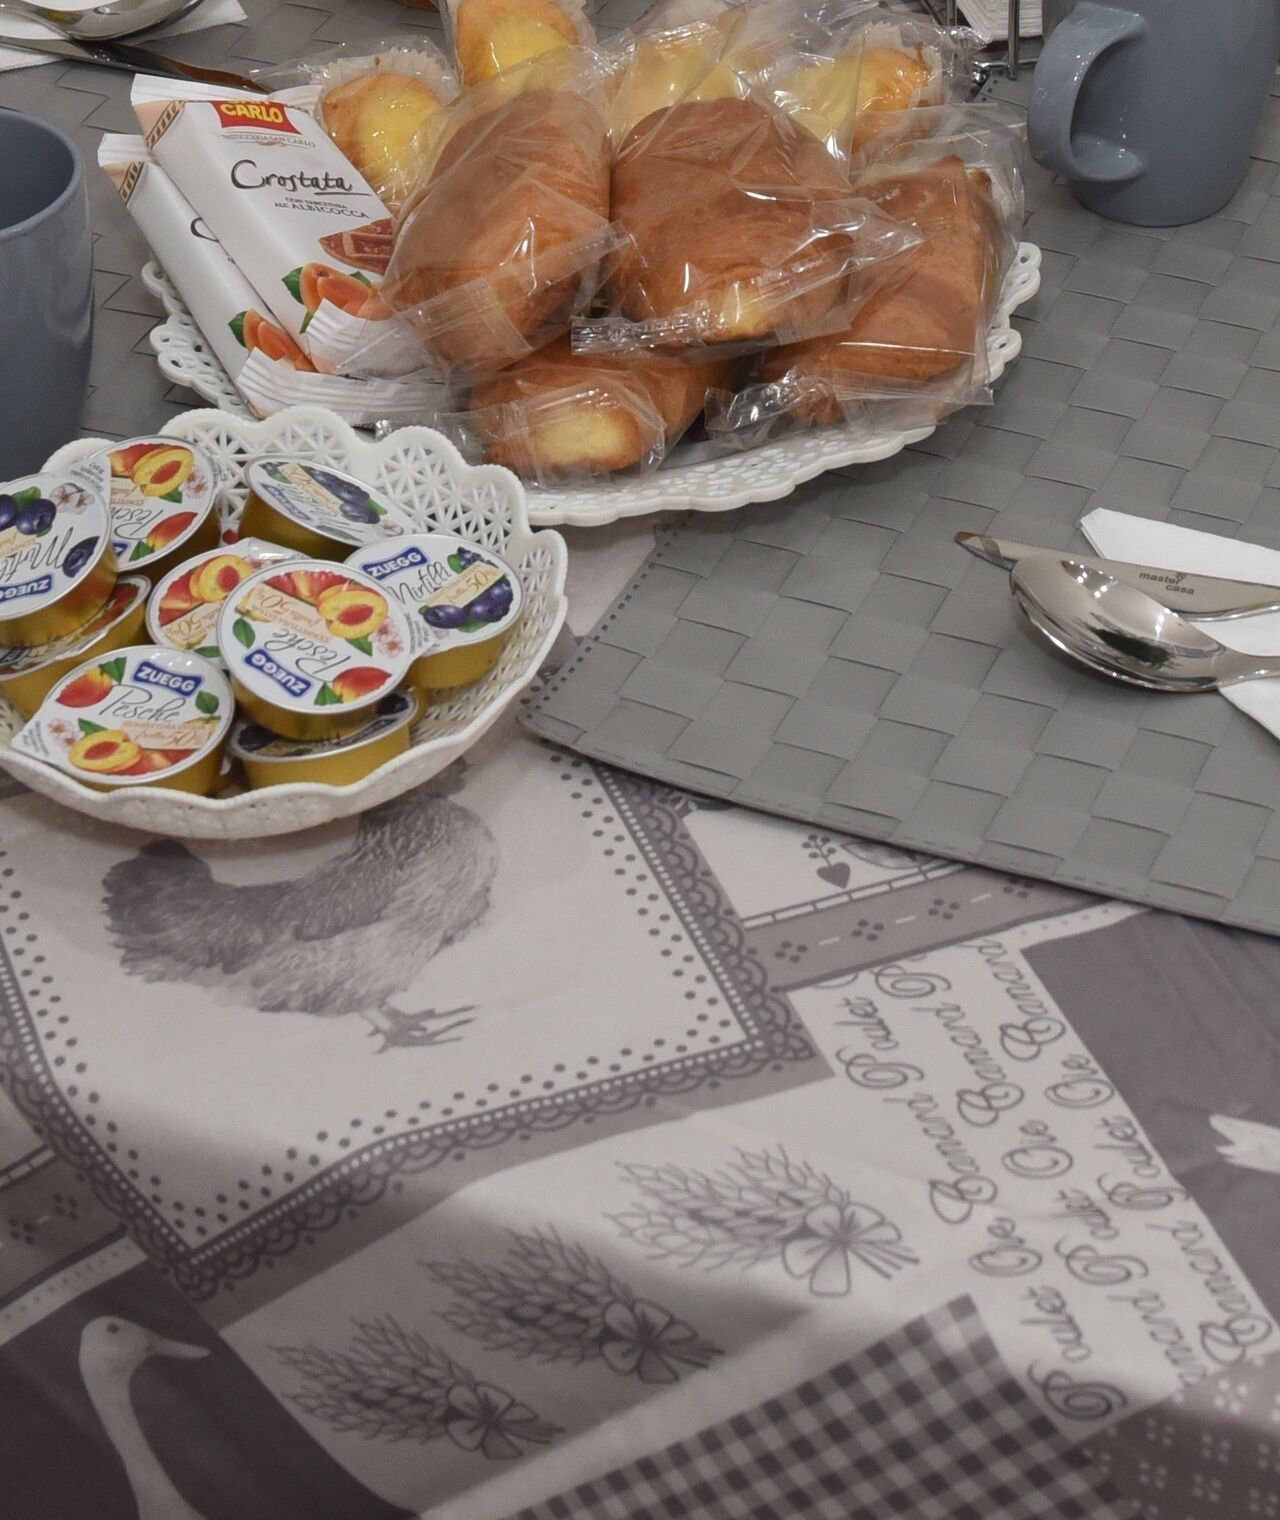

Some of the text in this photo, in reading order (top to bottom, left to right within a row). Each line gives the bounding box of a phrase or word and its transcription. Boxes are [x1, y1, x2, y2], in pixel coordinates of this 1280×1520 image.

[220, 103, 284, 124] CARLO
[230, 159, 354, 193] Crostata
[367, 552, 422, 577] ZUEGG
[252, 654, 307, 694] ZUEGG
[264, 628, 351, 684] Pesche
[136, 666, 196, 692] ZUEGG
[98, 683, 187, 721] Pesche
[1107, 1290, 1210, 1386] anard
